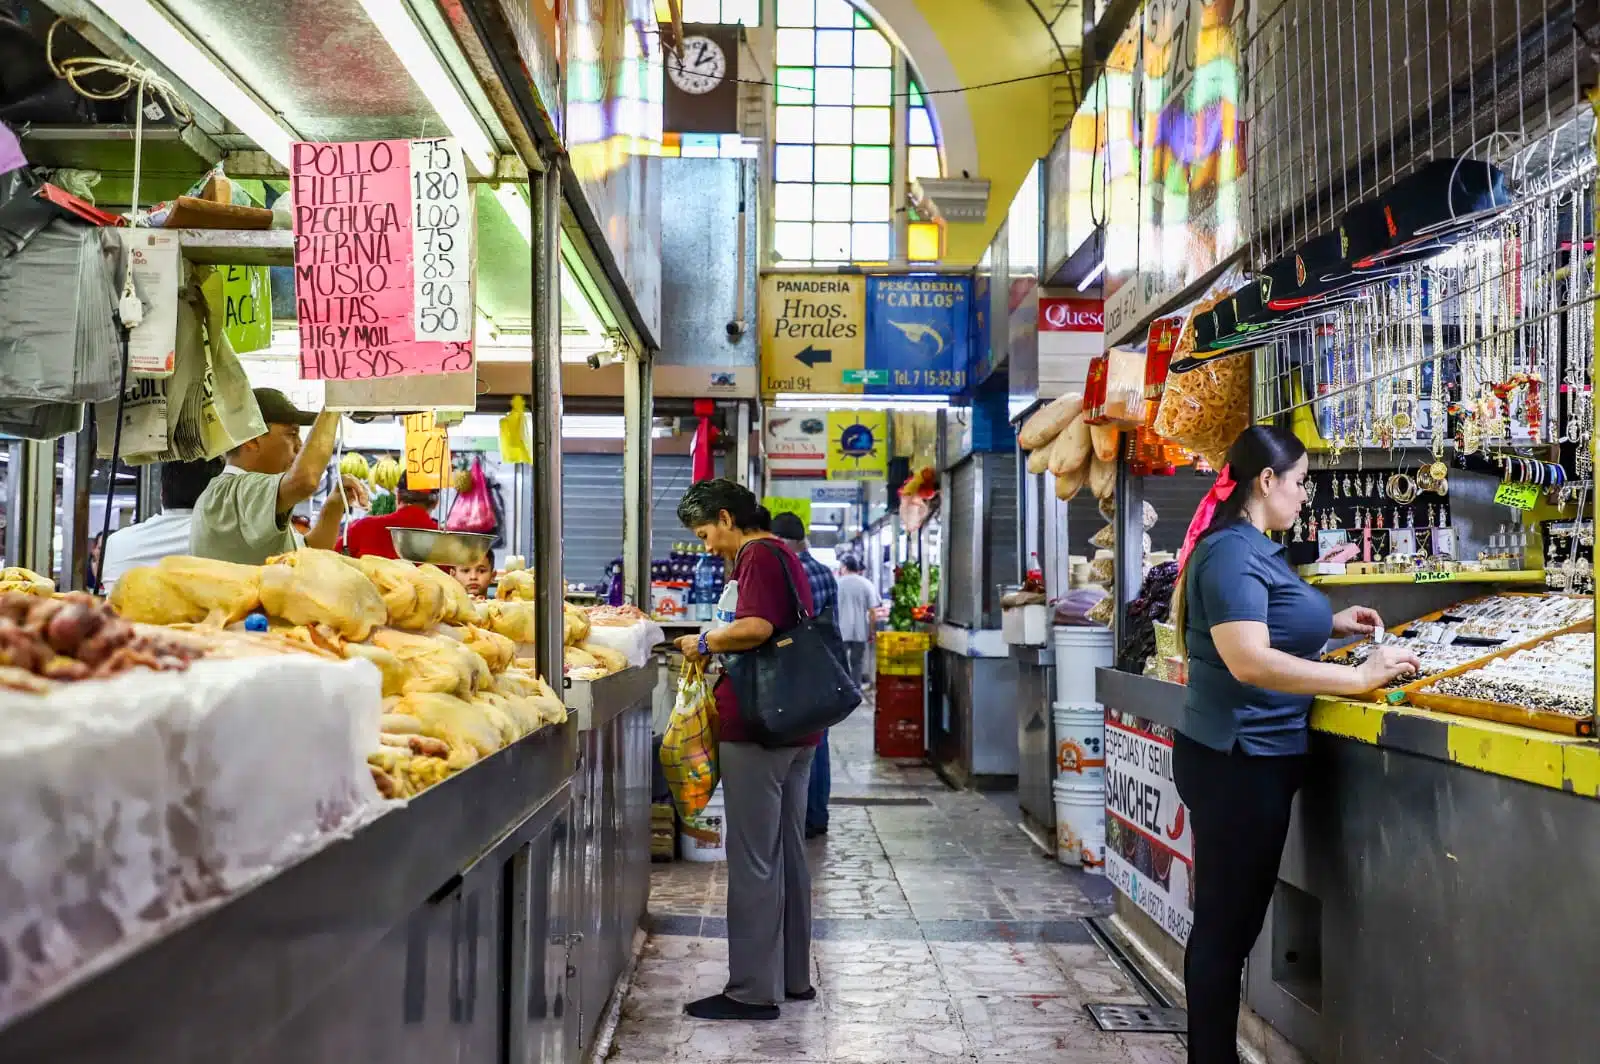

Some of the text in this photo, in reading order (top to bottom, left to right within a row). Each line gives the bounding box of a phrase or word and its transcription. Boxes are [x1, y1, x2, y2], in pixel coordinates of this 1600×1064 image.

[293, 139, 451, 175] POLLO 75
[293, 171, 459, 205] FILETE 180
[296, 203, 460, 234] PECHUGA 100
[294, 227, 454, 265] PIERNA 75
[296, 253, 455, 297] MUSLO 85
[299, 281, 453, 325] ALITAS 90
[782, 298, 848, 319] Hnos.
[300, 325, 336, 349] HIG
[337, 325, 350, 349] Y
[420, 306, 459, 333] 50
[773, 318, 858, 338] Perales
[300, 348, 405, 380] HUESOS
[893, 369, 911, 385] Tel.
[767, 376, 795, 390] Local
[1106, 727, 1139, 768] ESPECIAS
[1139, 741, 1147, 770] Y
[1148, 743, 1173, 783] SEMIL
[1105, 759, 1161, 836] SÁNCHEZ
